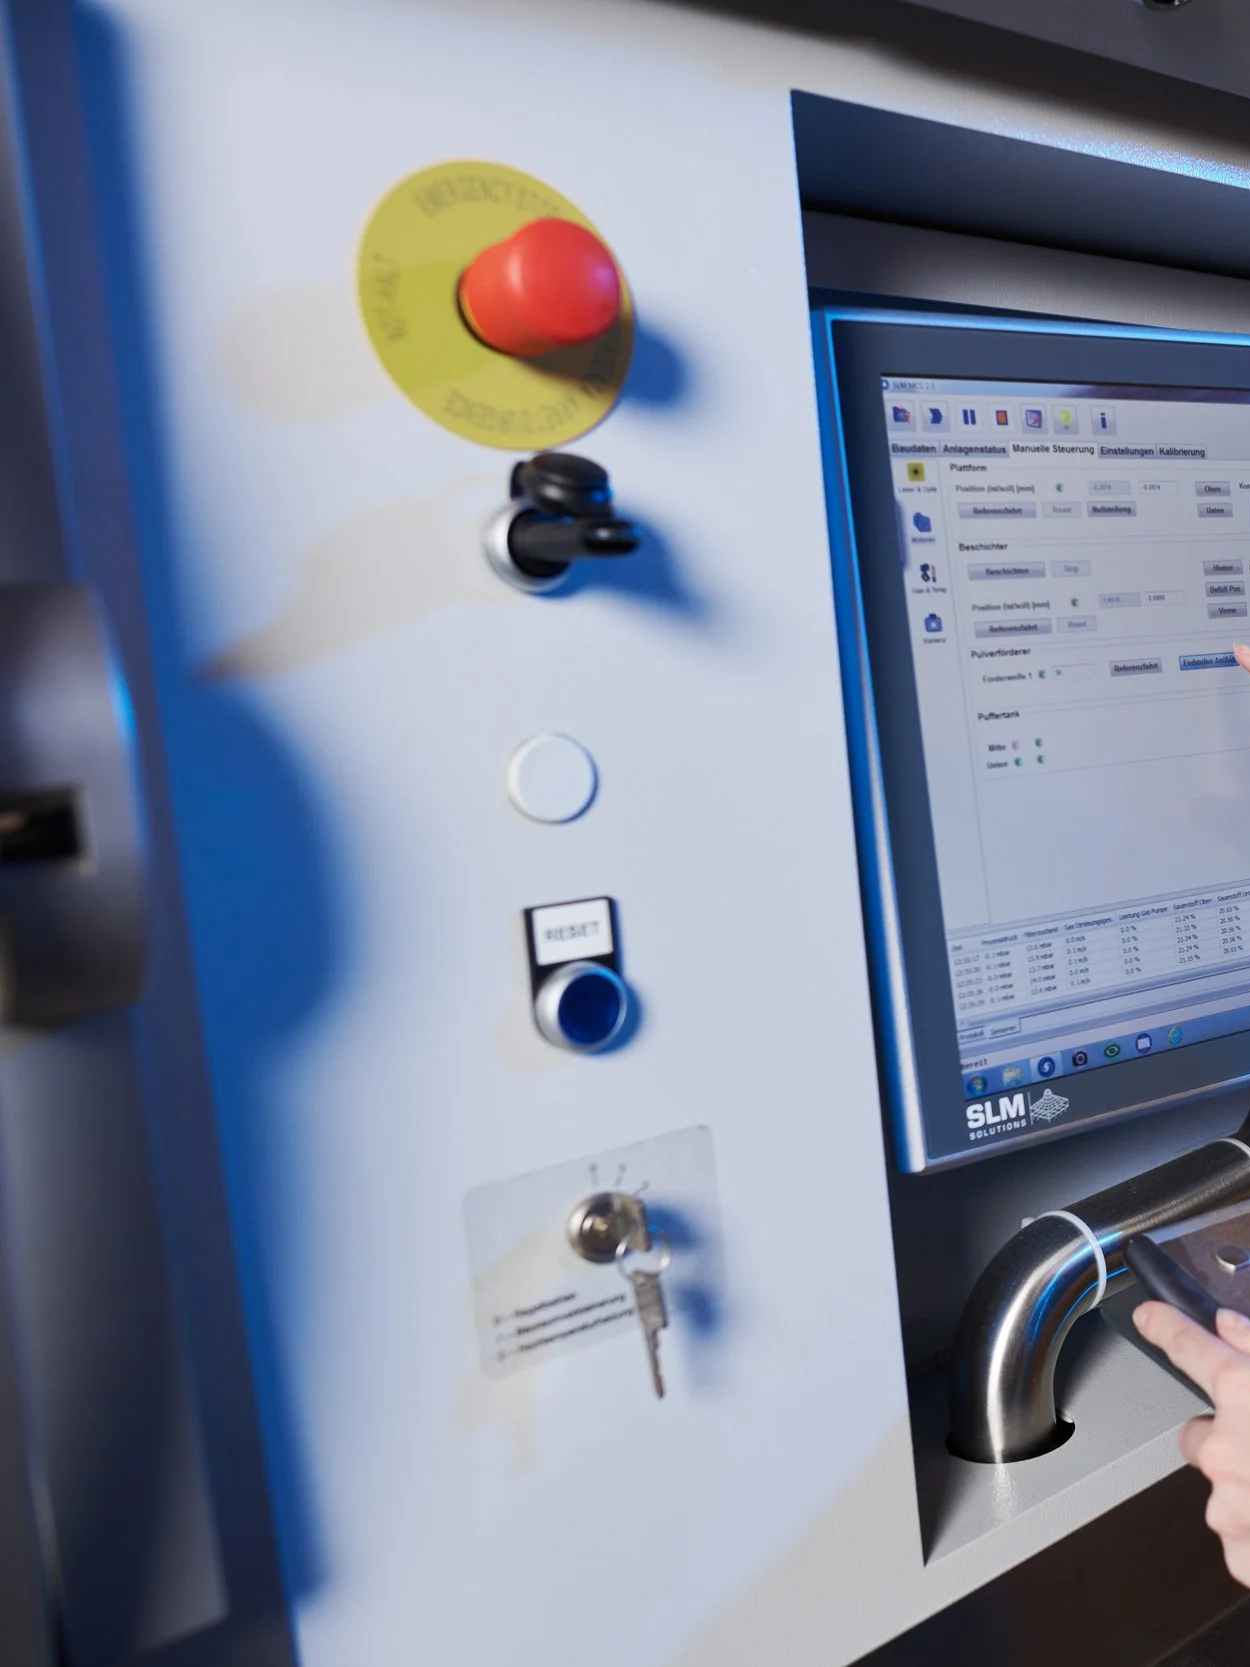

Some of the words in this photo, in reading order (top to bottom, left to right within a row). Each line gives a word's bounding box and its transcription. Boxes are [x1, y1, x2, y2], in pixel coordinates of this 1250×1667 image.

[892, 443, 936, 453] Baudaten
[943, 444, 1007, 455] Anlagenstatus
[1012, 444, 1050, 453] Manuelle
[1053, 445, 1095, 456] Steuerung
[1100, 446, 1154, 457] Einstellungen
[1159, 447, 1206, 458] Kalibrierung
[950, 463, 987, 472] Plattform
[955, 484, 985, 493] Position
[1204, 485, 1222, 493] Oben
[1092, 506, 1131, 515] Nullstellung
[1206, 507, 1225, 515] Unten
[959, 543, 1008, 552] Beschichter
[972, 604, 1001, 612] Position
[1114, 661, 1159, 672] Referenzfahrt
[978, 710, 1020, 721] Puffertank
[1217, 891, 1241, 902] Sauerstoff
[1173, 899, 1199, 910] Sauerstoff
[543, 921, 600, 942] RESET
[966, 1093, 1026, 1129] SLM
[969, 1118, 1027, 1141] SOLUTIONS
